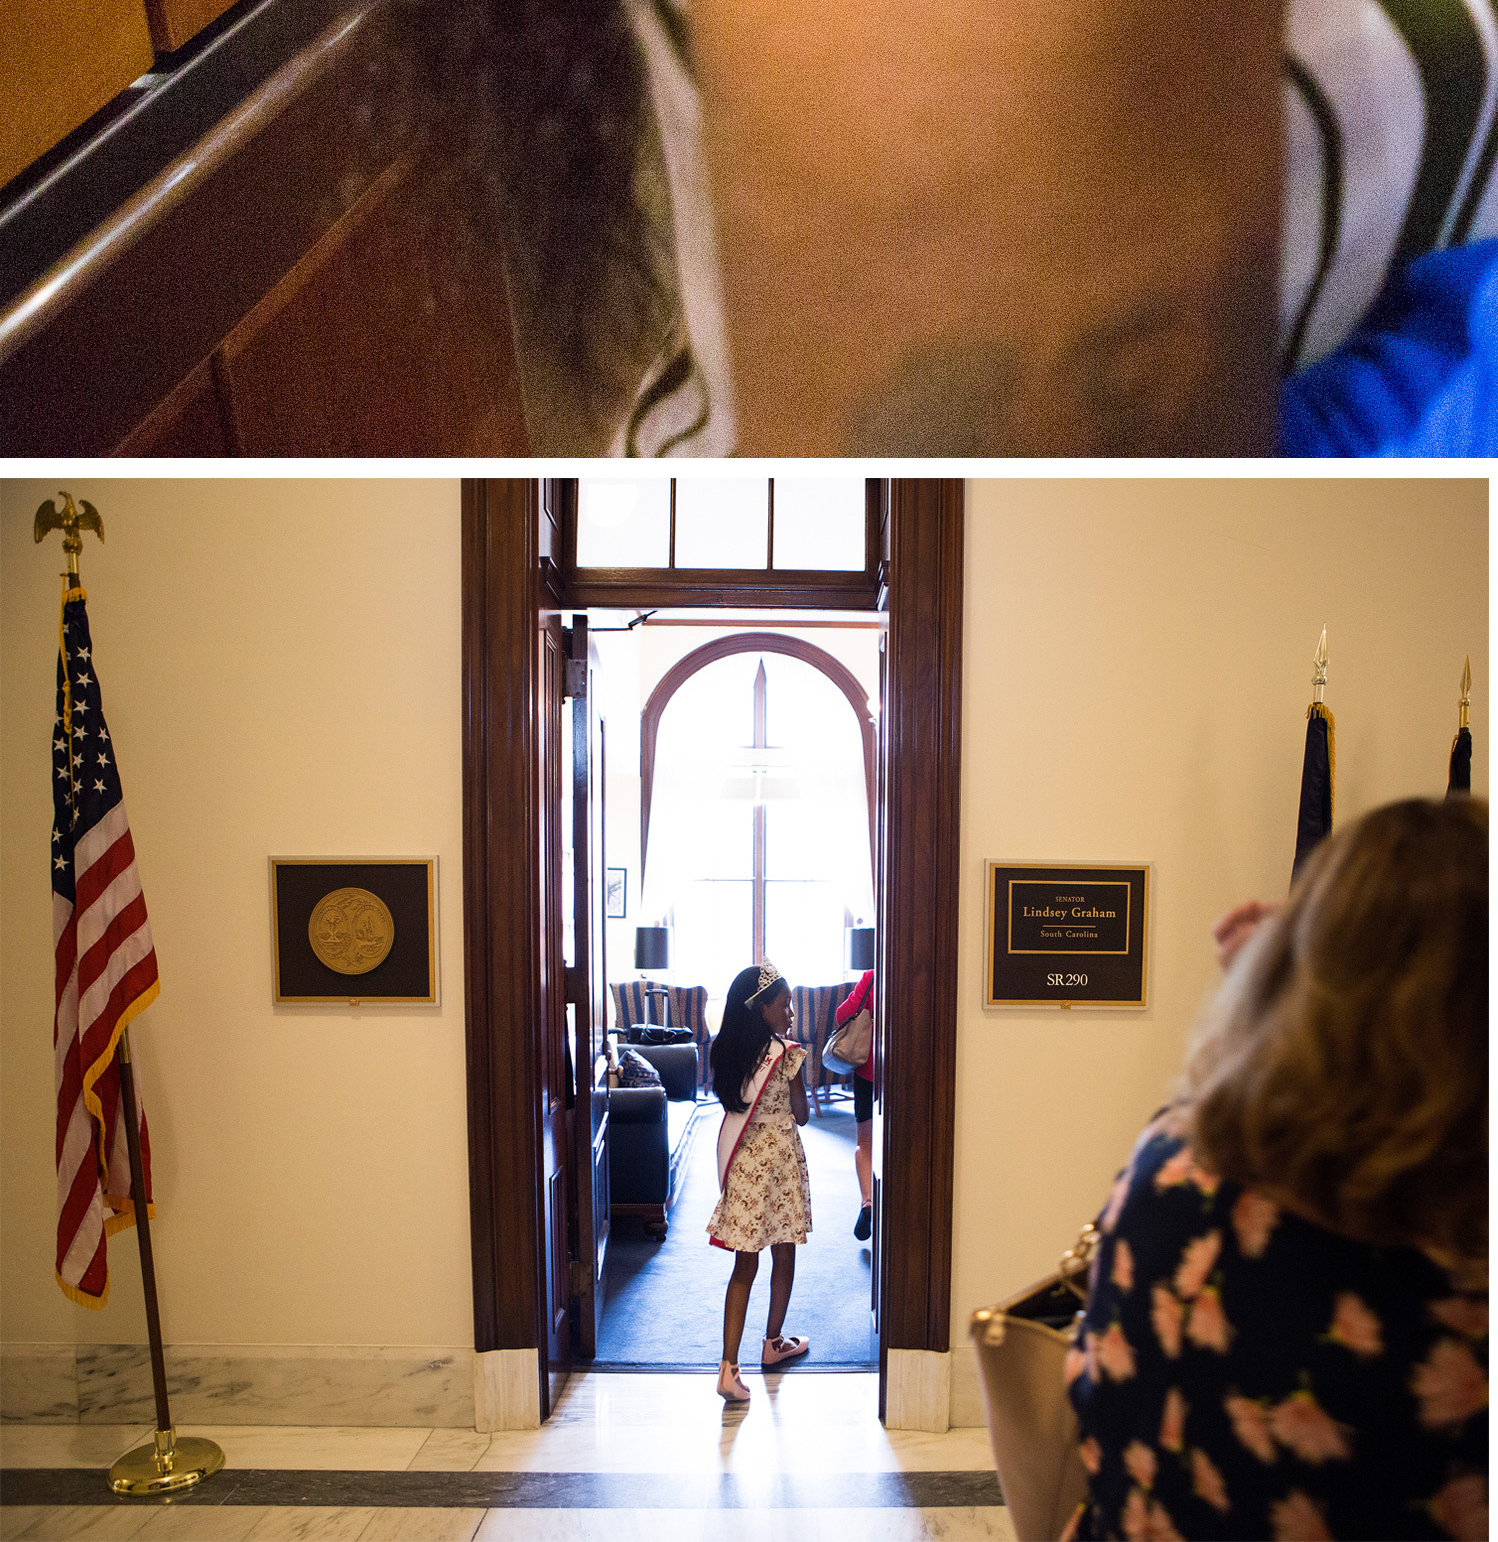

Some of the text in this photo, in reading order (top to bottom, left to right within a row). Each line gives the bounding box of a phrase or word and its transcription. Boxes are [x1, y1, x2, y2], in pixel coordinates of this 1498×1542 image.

[1023, 906, 1116, 920] Lindsey Graham
[1040, 929, 1098, 938] South Carolina
